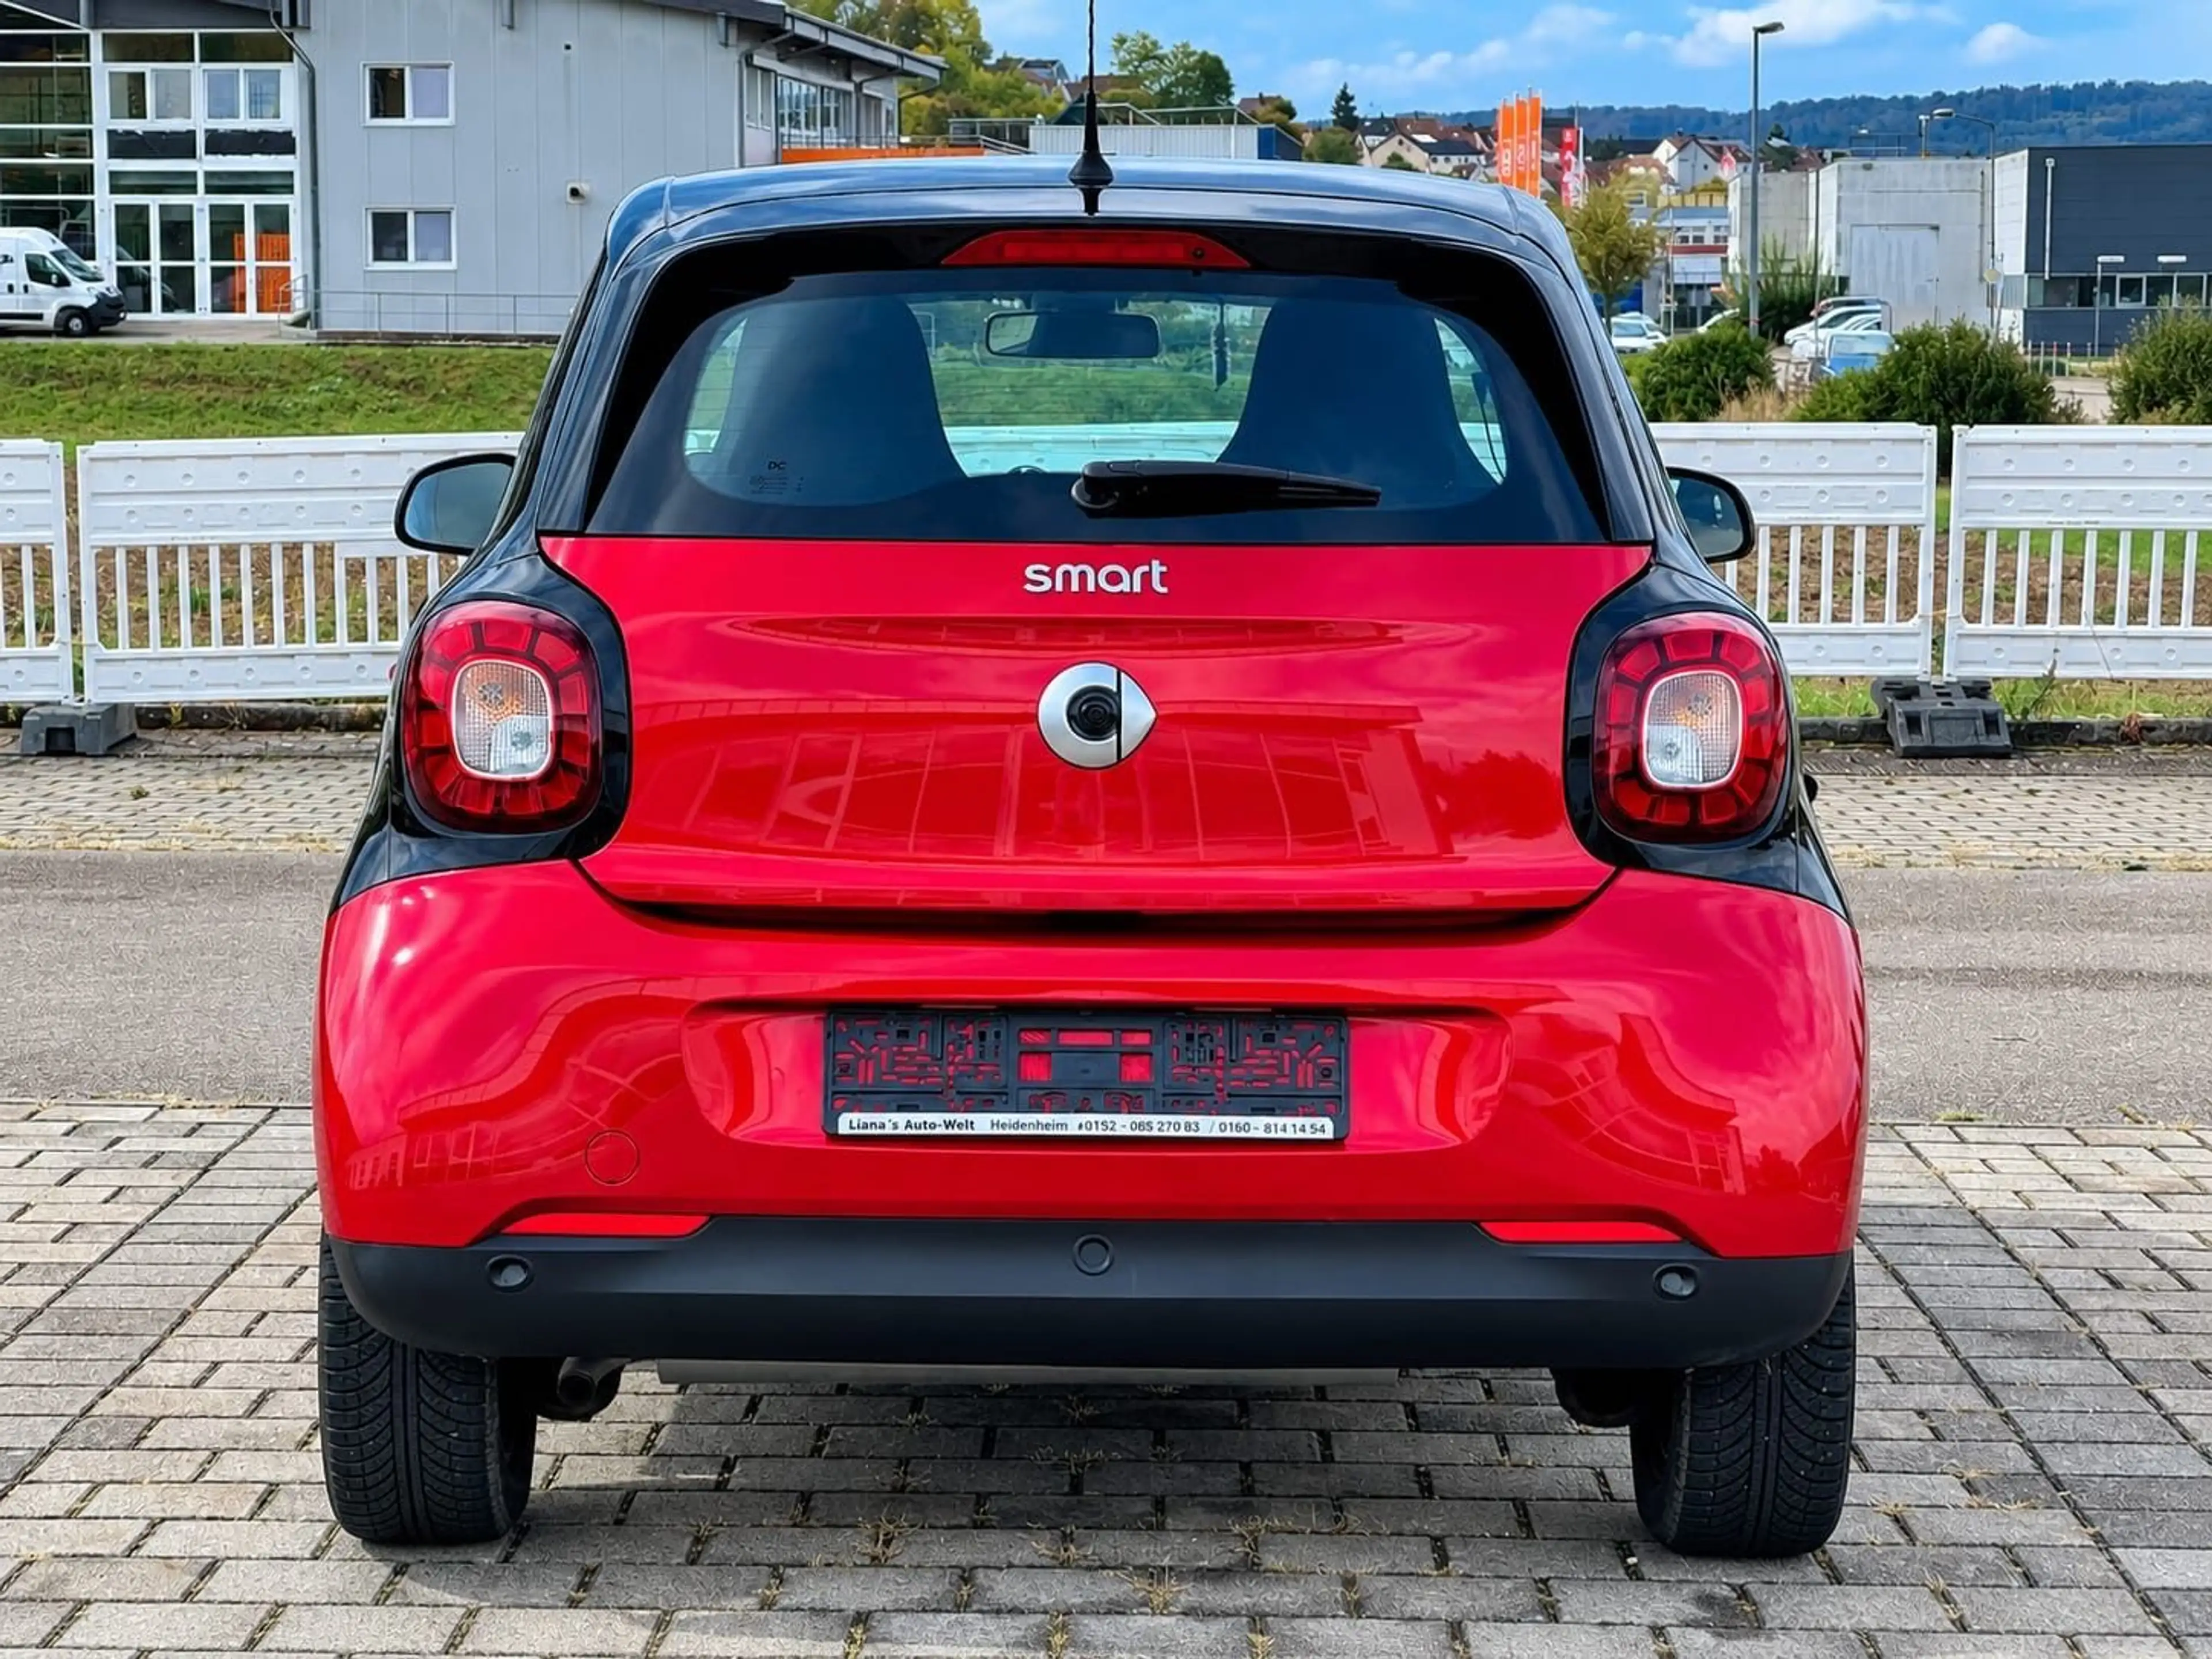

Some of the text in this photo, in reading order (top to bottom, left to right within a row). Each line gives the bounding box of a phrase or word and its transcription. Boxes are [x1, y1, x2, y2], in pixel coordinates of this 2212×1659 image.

[1024, 559, 1169, 593] smart
[904, 1119, 975, 1131] Auto-Welt
[990, 1119, 1069, 1131] Heidenheim
[1157, 1121, 1181, 1132] 270
[1218, 1122, 1251, 1133] 0160
[1263, 1123, 1287, 1134] 814
[1291, 1123, 1306, 1134] 14
